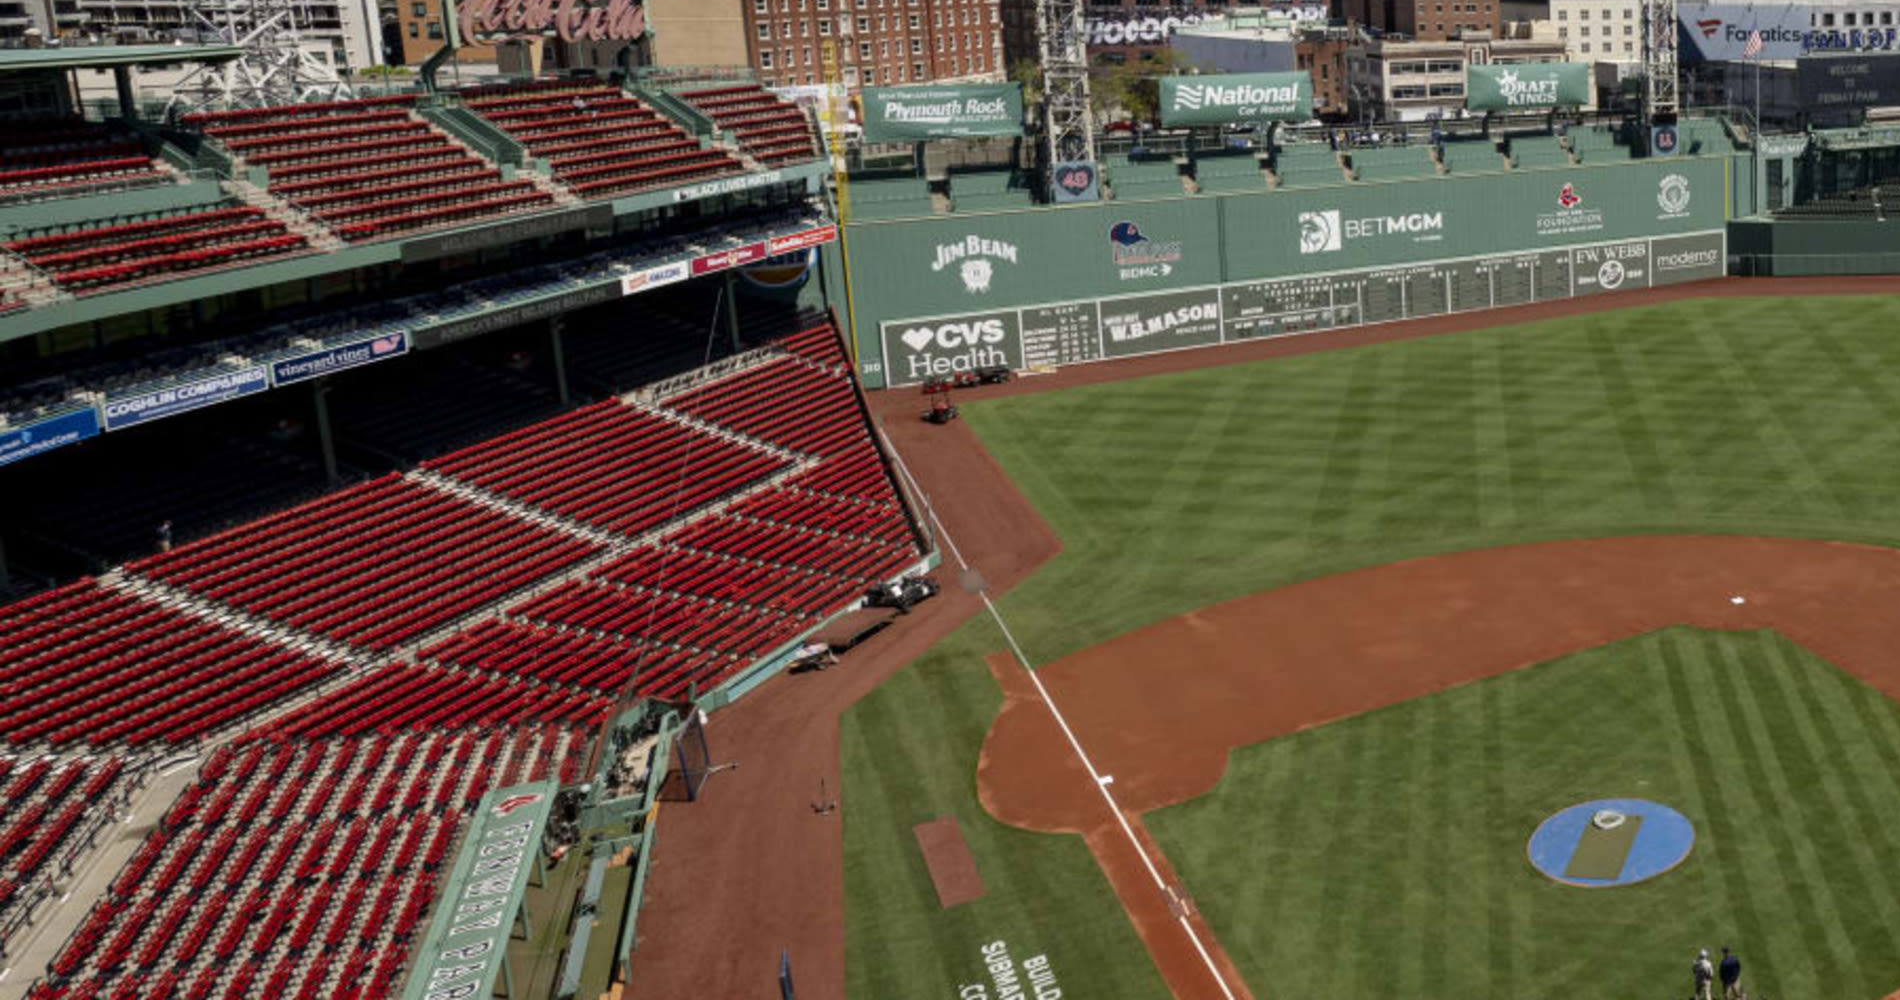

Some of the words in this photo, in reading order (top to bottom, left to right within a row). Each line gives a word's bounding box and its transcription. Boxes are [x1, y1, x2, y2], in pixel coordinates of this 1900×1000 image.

[1802, 30, 1864, 50] BANK
[1869, 27, 1898, 49] OF
[1204, 81, 1299, 106] National
[1500, 79, 1559, 97] DRAFT
[1507, 92, 1557, 105] KINGS
[884, 100, 962, 119] Plymouth
[965, 96, 1007, 114] Rock
[1238, 106, 1257, 116] Car
[1260, 104, 1296, 115] Rental
[1344, 212, 1443, 239] BETMGM
[931, 241, 966, 272] JIM
[966, 234, 1018, 264] BEAM
[1604, 243, 1646, 260] WEBB
[1656, 249, 1718, 267] moderna
[936, 319, 1005, 349] CVS
[279, 354, 336, 378] vineyard
[337, 345, 371, 364] vines
[907, 345, 1008, 378] Health
[106, 386, 176, 418] COGHLIN
[177, 368, 264, 401] COMPANIES
[449, 820, 534, 936] FENWAY
